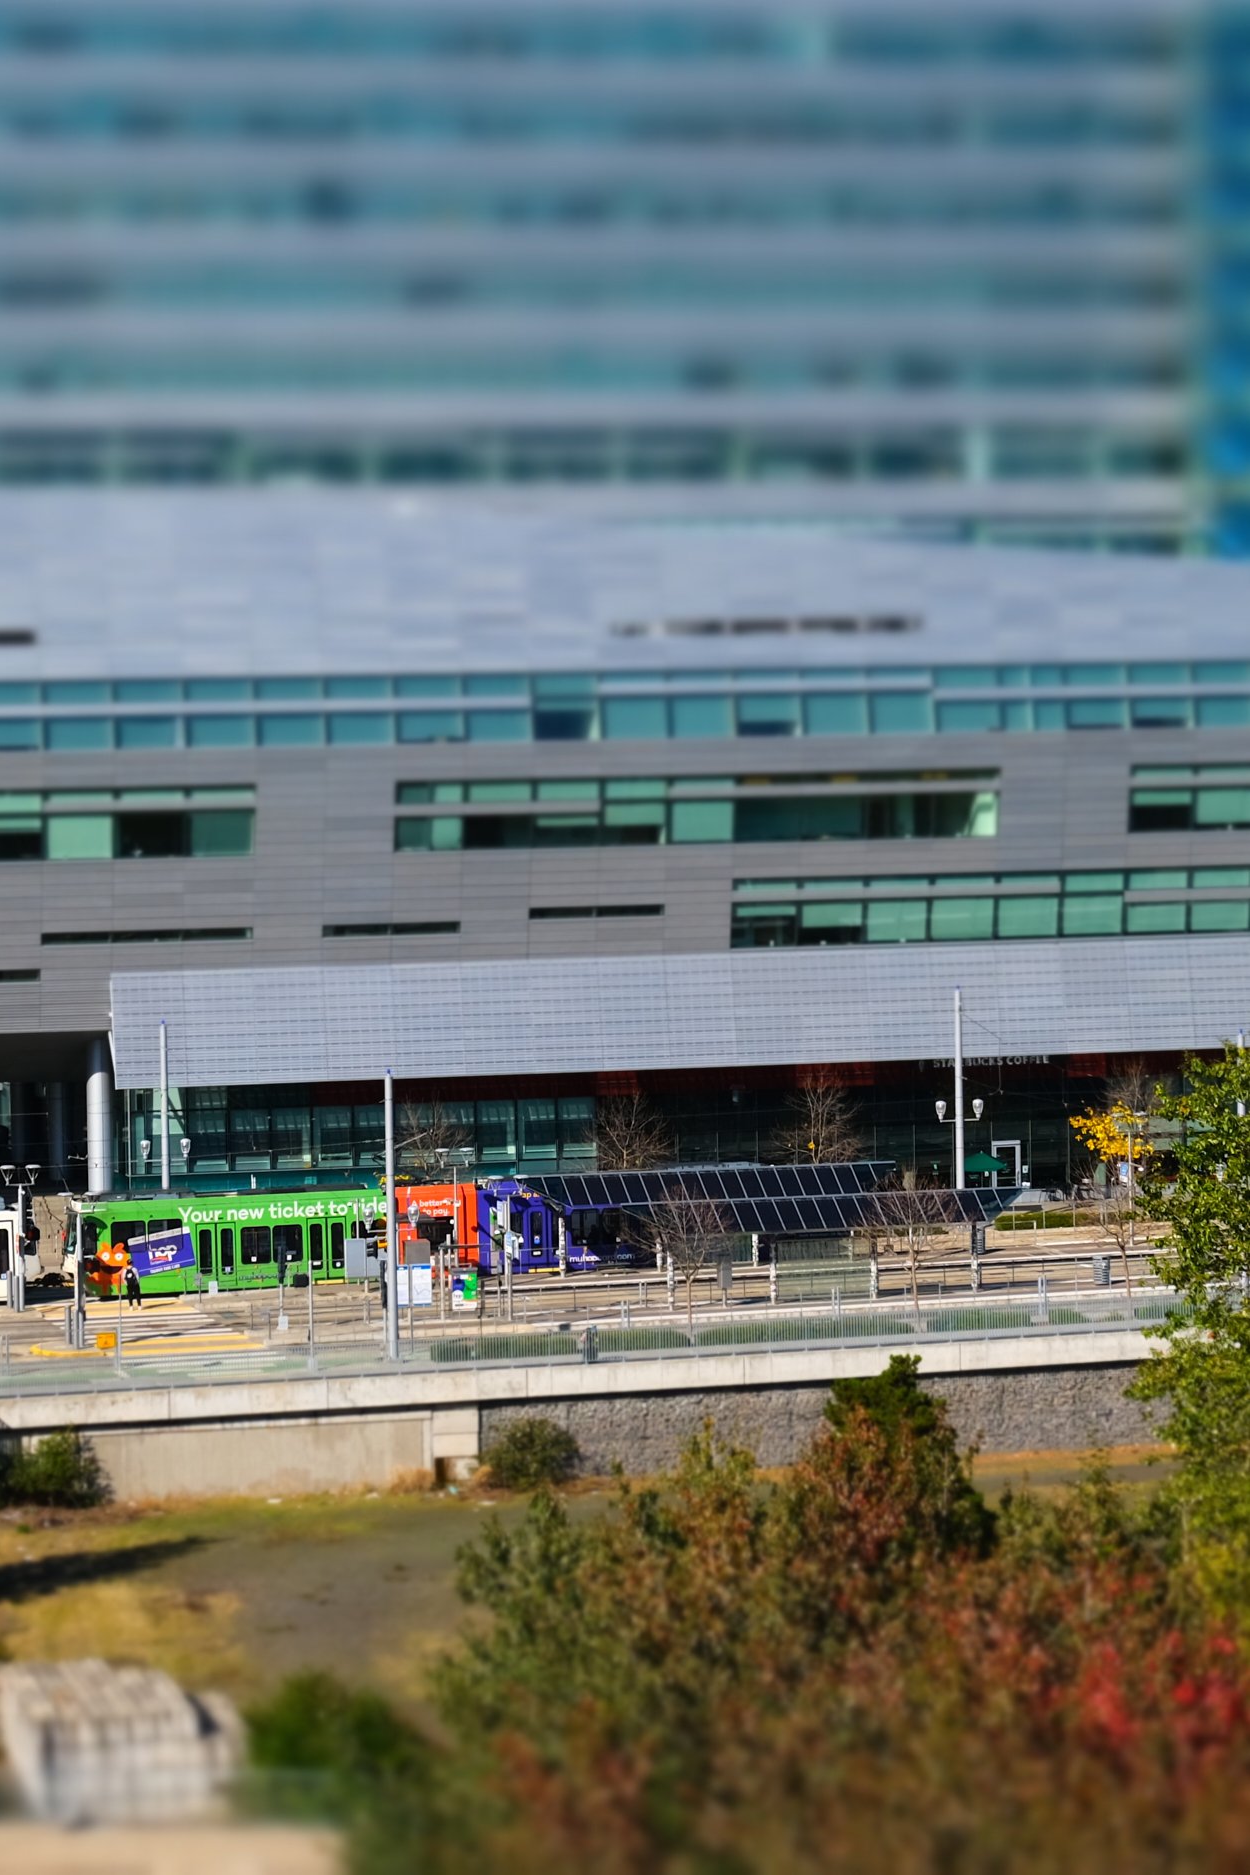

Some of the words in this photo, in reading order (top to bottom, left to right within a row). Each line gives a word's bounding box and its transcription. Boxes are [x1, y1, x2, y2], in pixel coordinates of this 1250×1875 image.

[933, 1056, 1003, 1068] STABUCKS
[419, 1198, 443, 1207] better
[178, 1206, 222, 1222] Your
[227, 1207, 264, 1221] new
[268, 1201, 324, 1219] ticket
[328, 1201, 348, 1216] to
